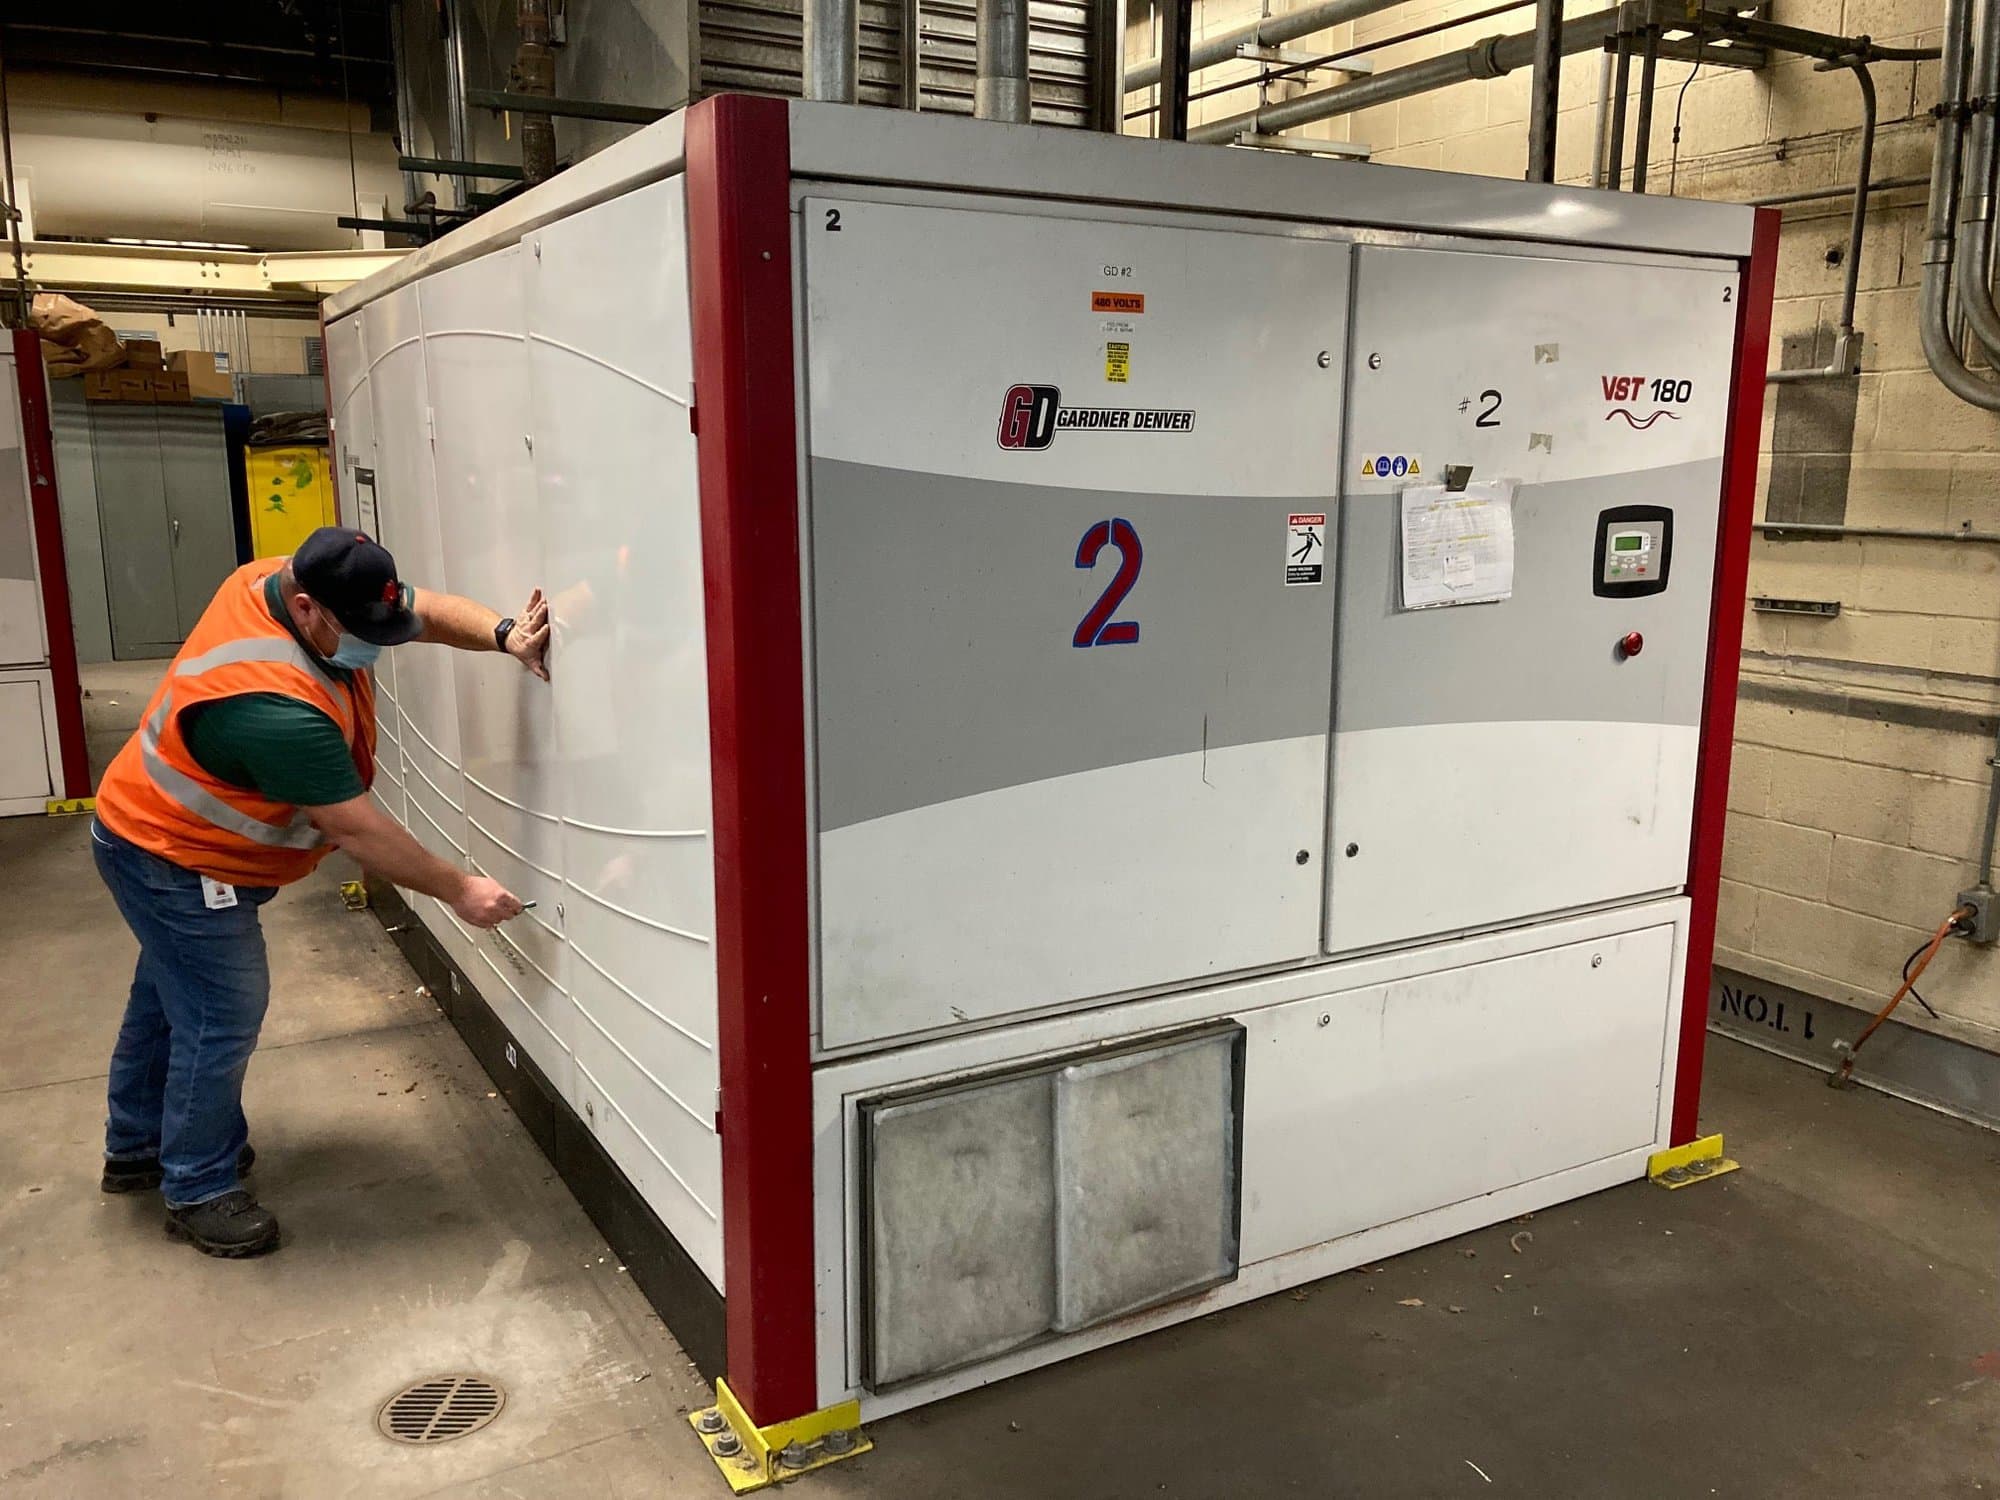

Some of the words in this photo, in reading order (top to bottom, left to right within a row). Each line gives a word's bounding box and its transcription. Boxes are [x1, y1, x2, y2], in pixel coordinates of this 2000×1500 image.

[825, 208, 842, 232] 2
[1103, 265, 1119, 277] GD
[1120, 266, 1132, 278] #2
[1094, 297, 1111, 308] 480
[1113, 298, 1141, 309] VOLTS
[1722, 286, 1732, 303] 2
[1107, 343, 1129, 351] CAUTION
[1601, 375, 1646, 401] VST
[1649, 378, 1693, 403] 180
[998, 384, 1062, 450] GD
[1056, 409, 1130, 429] GARDNER
[1133, 411, 1192, 430] DENVER
[1297, 516, 1323, 525] DANGER
[1071, 516, 1144, 649] 2
